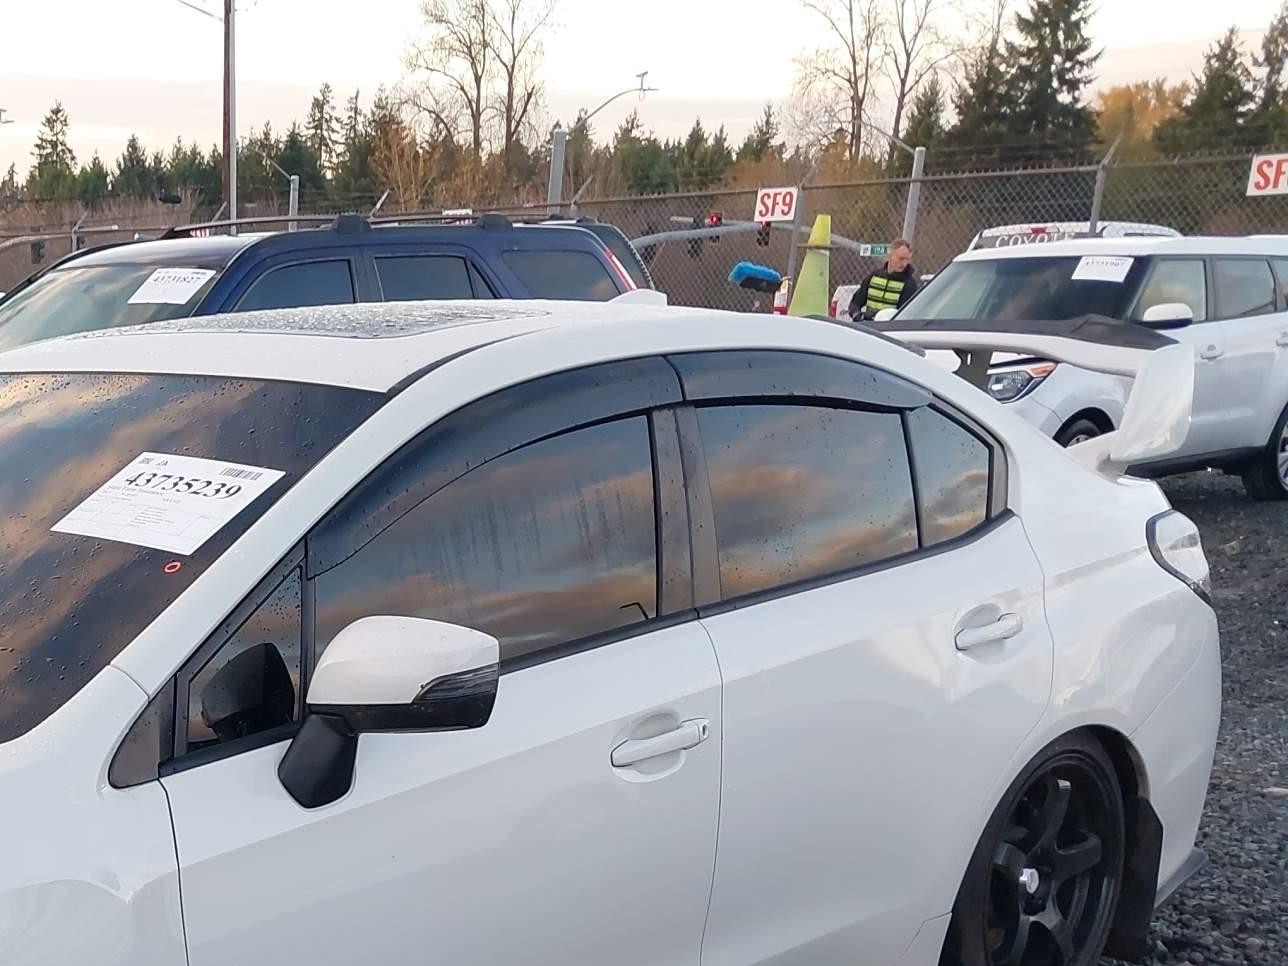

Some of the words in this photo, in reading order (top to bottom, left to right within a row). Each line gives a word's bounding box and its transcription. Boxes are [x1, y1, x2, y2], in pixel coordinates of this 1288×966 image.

[1254, 159, 1288, 191] SF
[758, 191, 794, 217] SF9
[125, 471, 243, 500] 43735239
